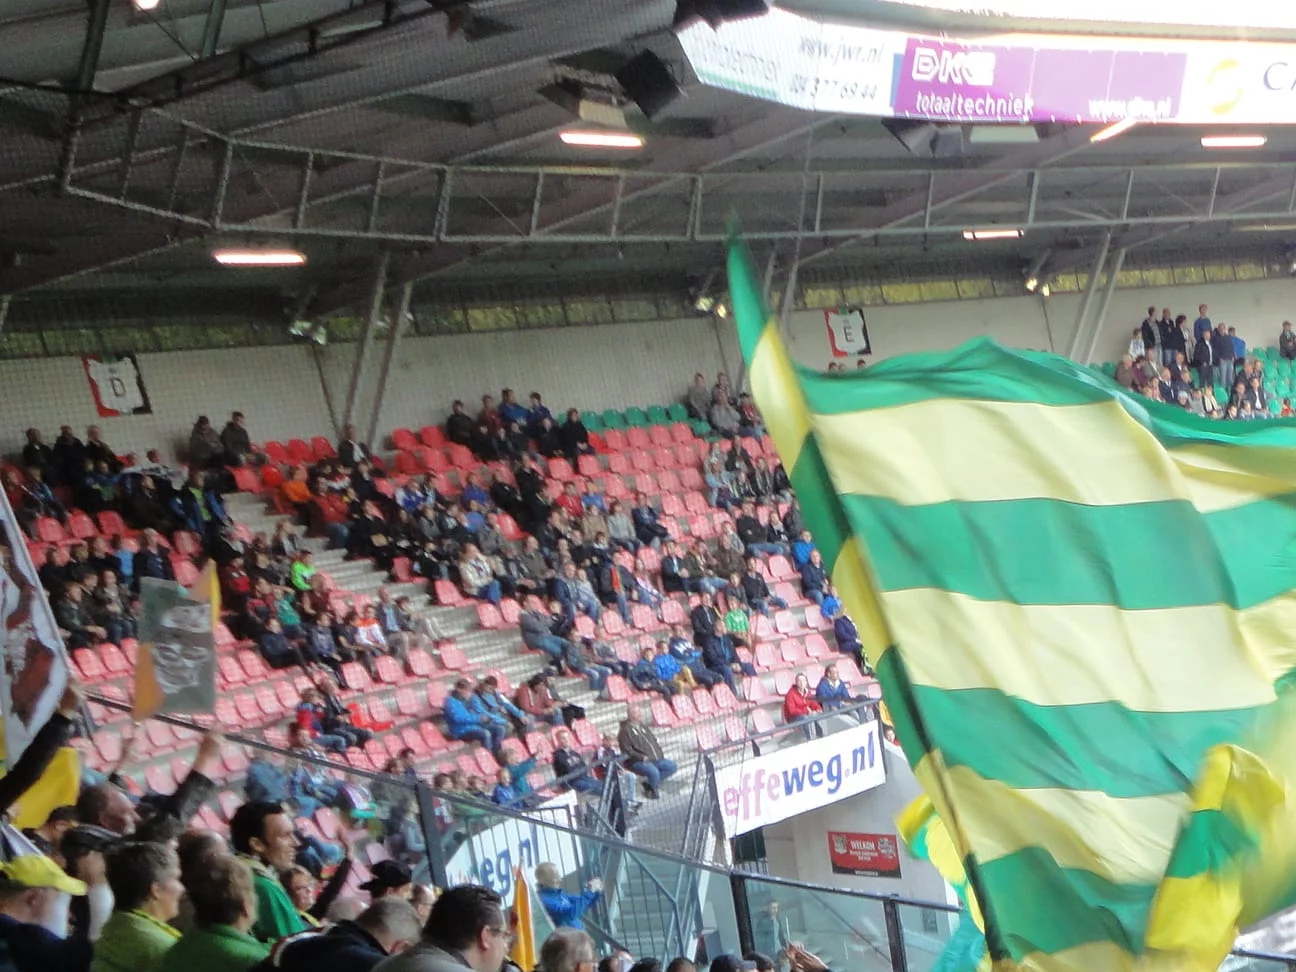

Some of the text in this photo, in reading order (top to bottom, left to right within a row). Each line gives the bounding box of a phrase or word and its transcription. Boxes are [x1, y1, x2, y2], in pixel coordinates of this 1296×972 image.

[916, 91, 1034, 116] totaaltechniek
[109, 376, 127, 397] D
[723, 730, 876, 821] effeweg.nl
